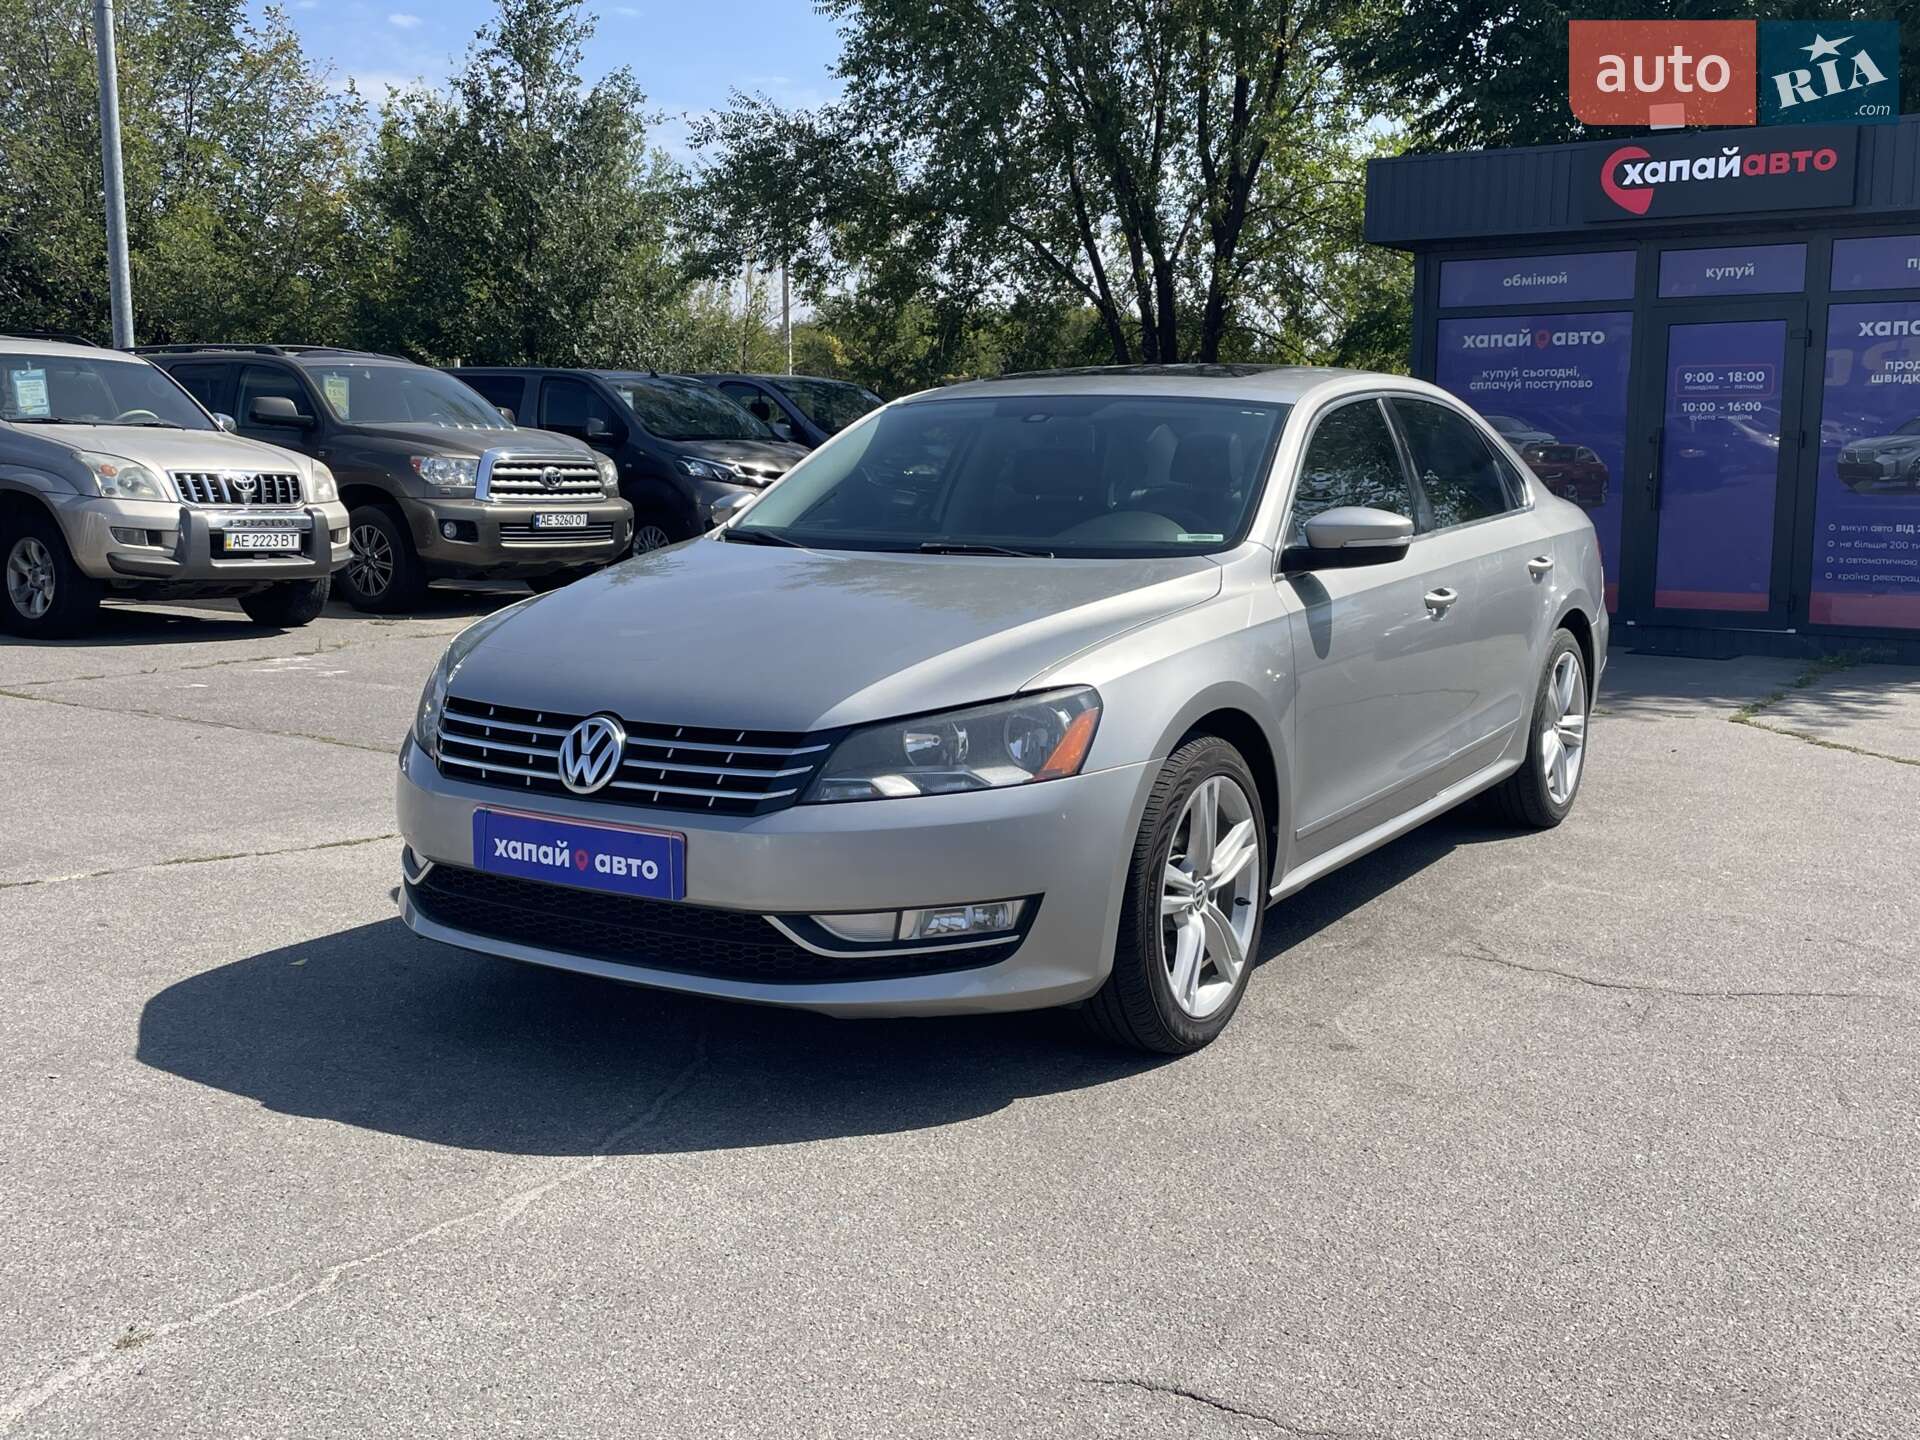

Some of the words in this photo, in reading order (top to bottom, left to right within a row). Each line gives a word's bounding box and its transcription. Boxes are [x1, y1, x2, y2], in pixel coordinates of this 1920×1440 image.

[1907, 257, 1920, 271] п
[1705, 263, 1755, 280] купуй
[1503, 271, 1568, 287] обмінюй
[1462, 328, 1532, 349] хапай
[1551, 330, 1606, 346] авто
[1482, 367, 1519, 380] купуй
[1522, 366, 1580, 379] сьогодні,
[1684, 372, 1715, 384] 9:00
[1727, 371, 1765, 383] 18:00
[1469, 379, 1522, 392] сплачуй
[1525, 379, 1593, 392] поступово
[1681, 402, 1716, 413] 10:00
[1727, 401, 1762, 412] 16:00
[541, 514, 553, 526] AE
[554, 514, 574, 526] 5260
[1870, 525, 1893, 533] авто
[1895, 524, 1915, 534] ВІД
[233, 534, 250, 547] AE
[252, 534, 279, 547] 2223
[281, 534, 297, 547] BT
[1889, 541, 1909, 550] 200
[493, 837, 570, 868] хапай
[594, 853, 659, 880] авто
